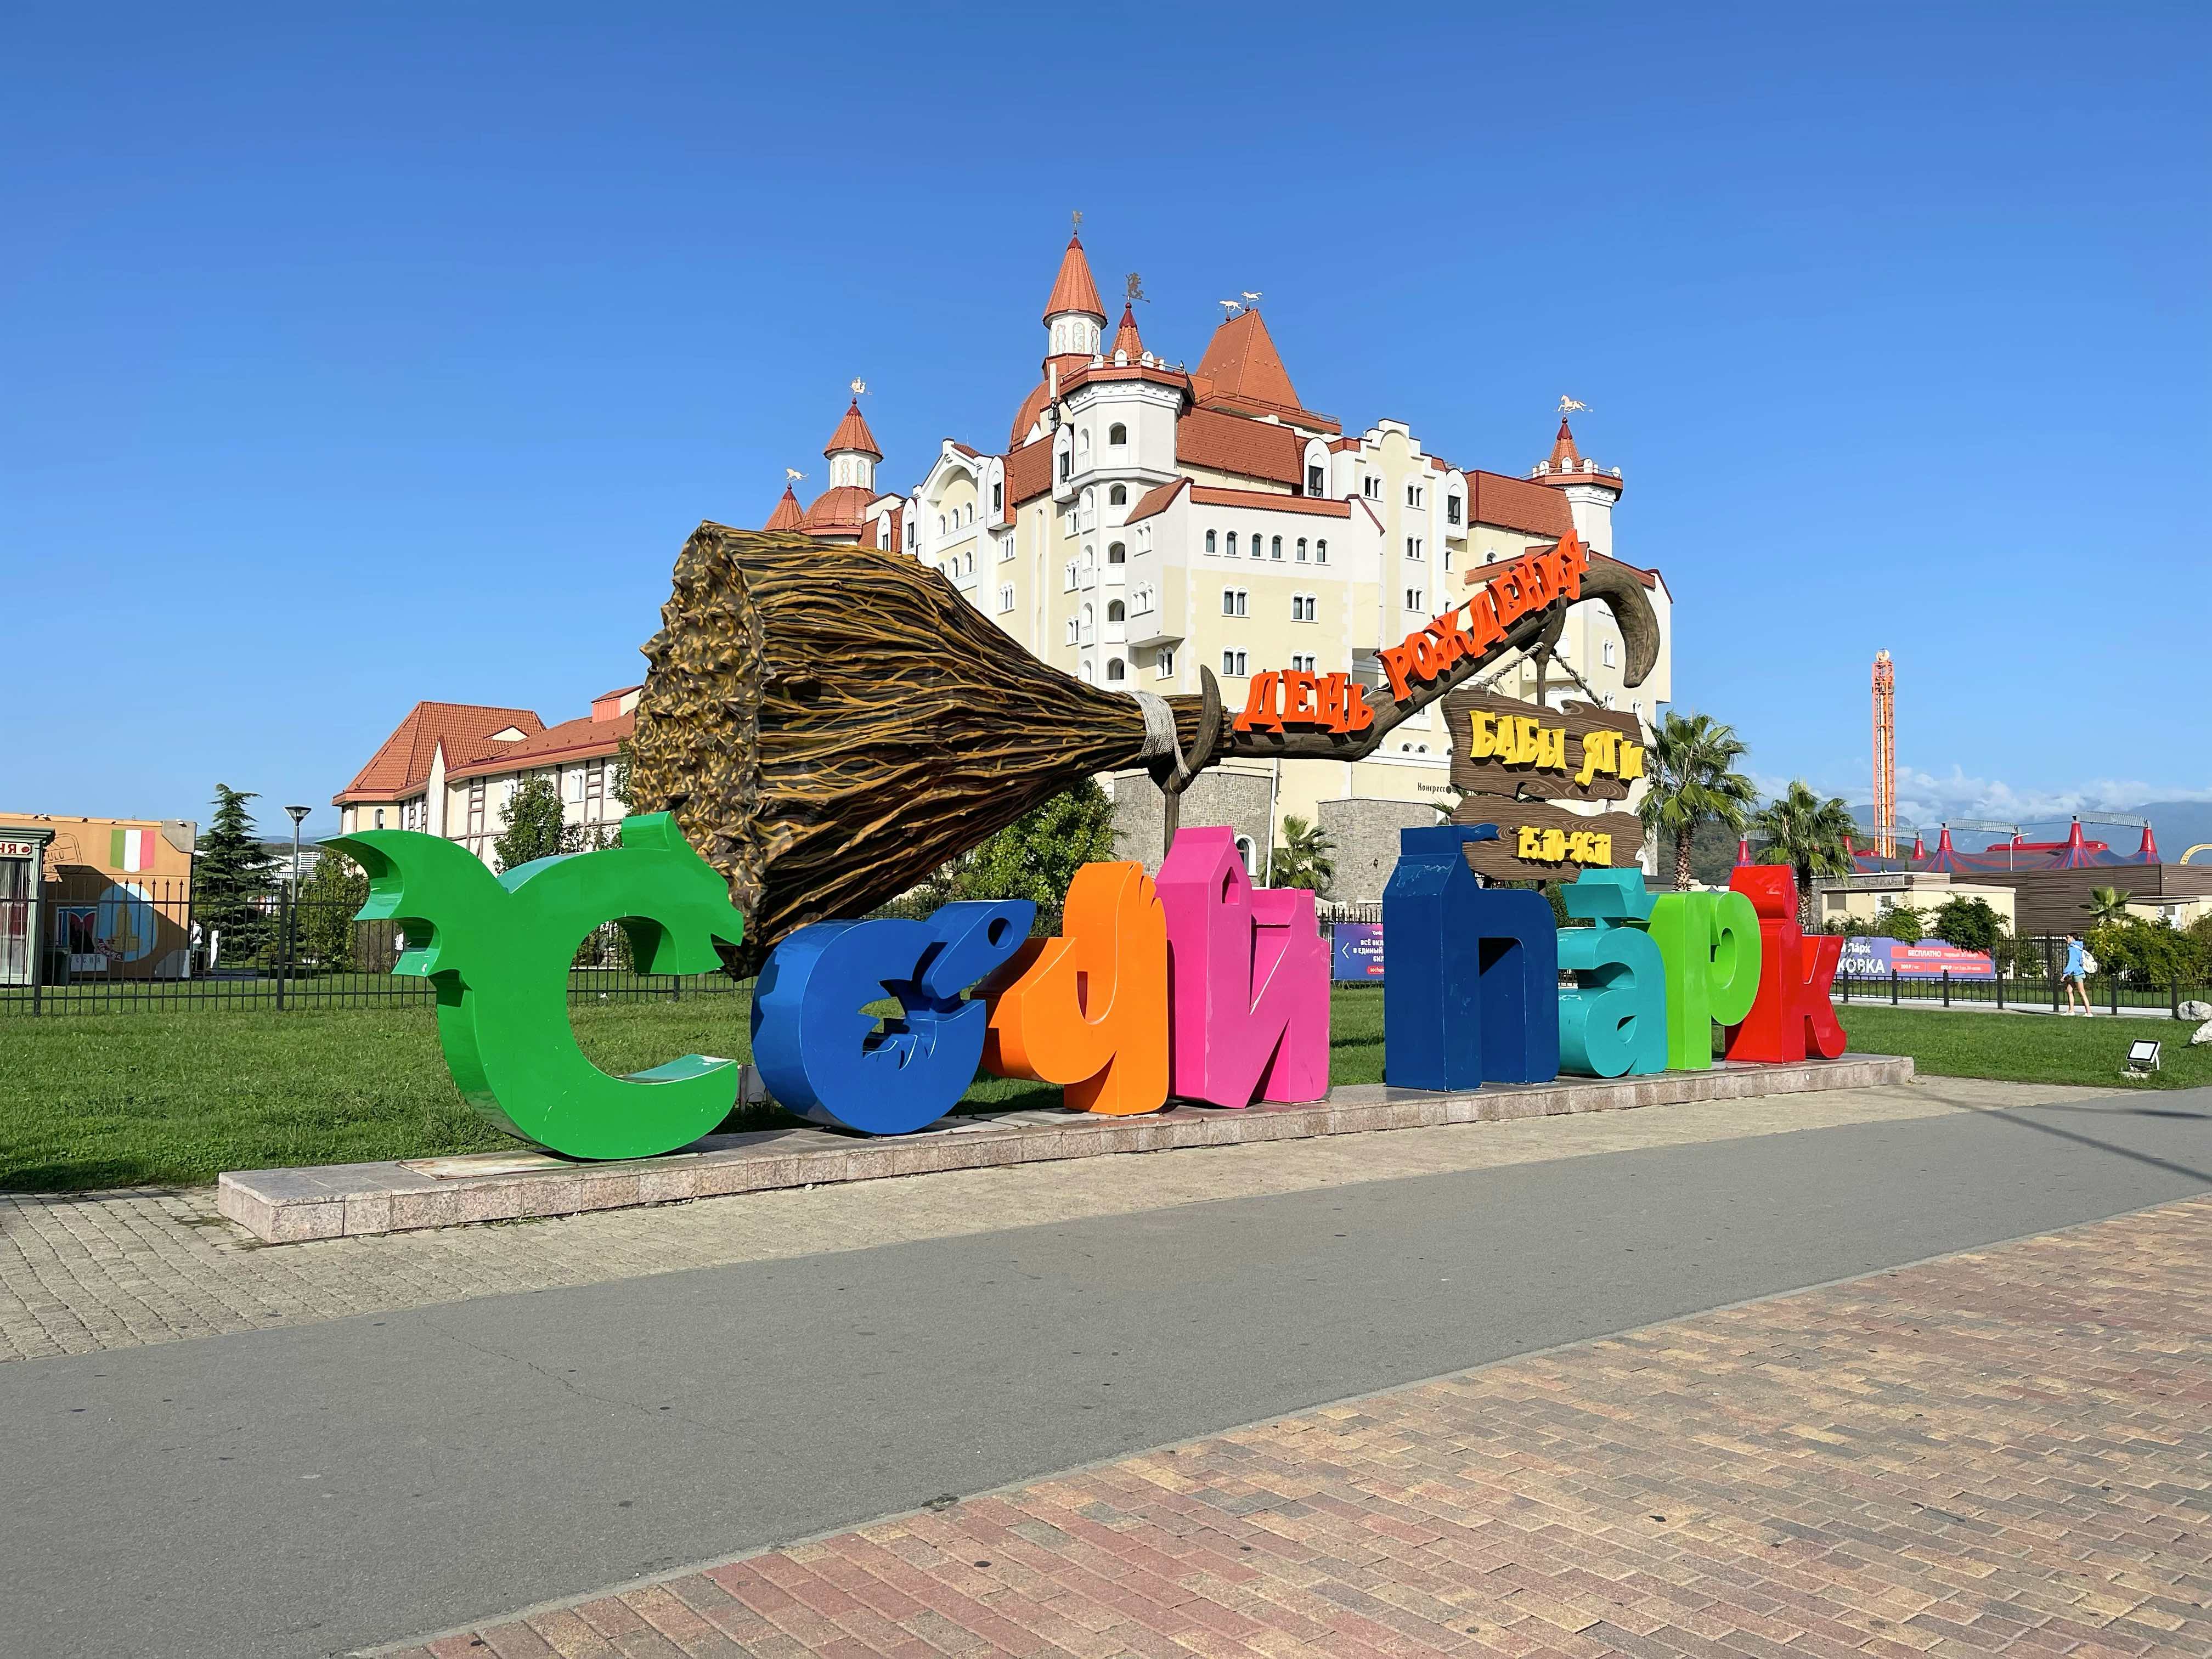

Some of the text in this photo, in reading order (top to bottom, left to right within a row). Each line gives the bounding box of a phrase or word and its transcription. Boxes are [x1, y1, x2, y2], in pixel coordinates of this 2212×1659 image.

[1233, 528, 1590, 734] ДЕНЬ РОЖДЕНИЯ
[1469, 710, 1645, 787] БАБЫ ЯГИ
[1418, 782, 1446, 794] Конгресс
[1358, 946, 1383, 955] ЕДИНЫЙ
[1908, 950, 1942, 958] БЕСПЛАТНО
[1836, 957, 1886, 974] КОВКА
